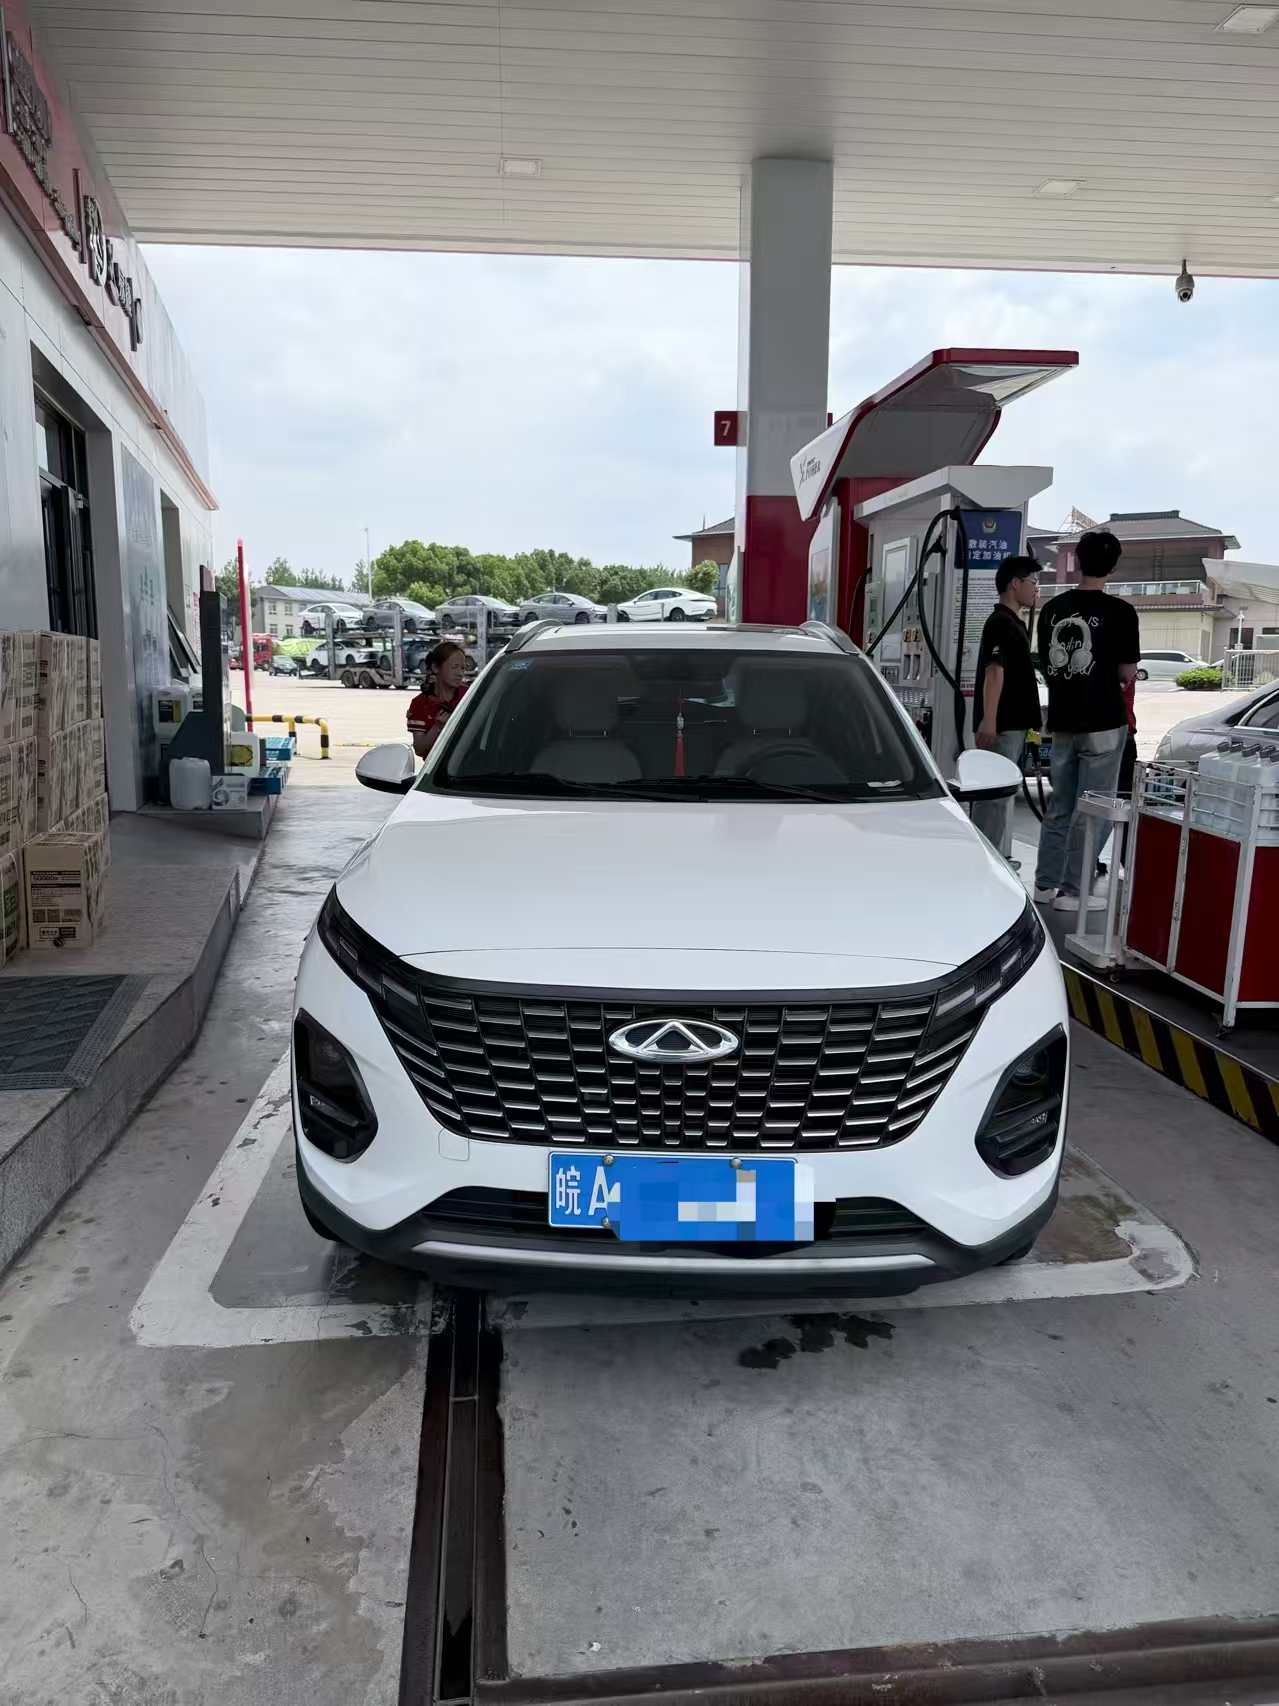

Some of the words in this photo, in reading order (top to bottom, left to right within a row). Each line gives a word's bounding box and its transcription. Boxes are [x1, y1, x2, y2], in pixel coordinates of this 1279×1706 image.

[720, 420, 731, 437] 7
[968, 539, 1008, 550] 散装汽油
